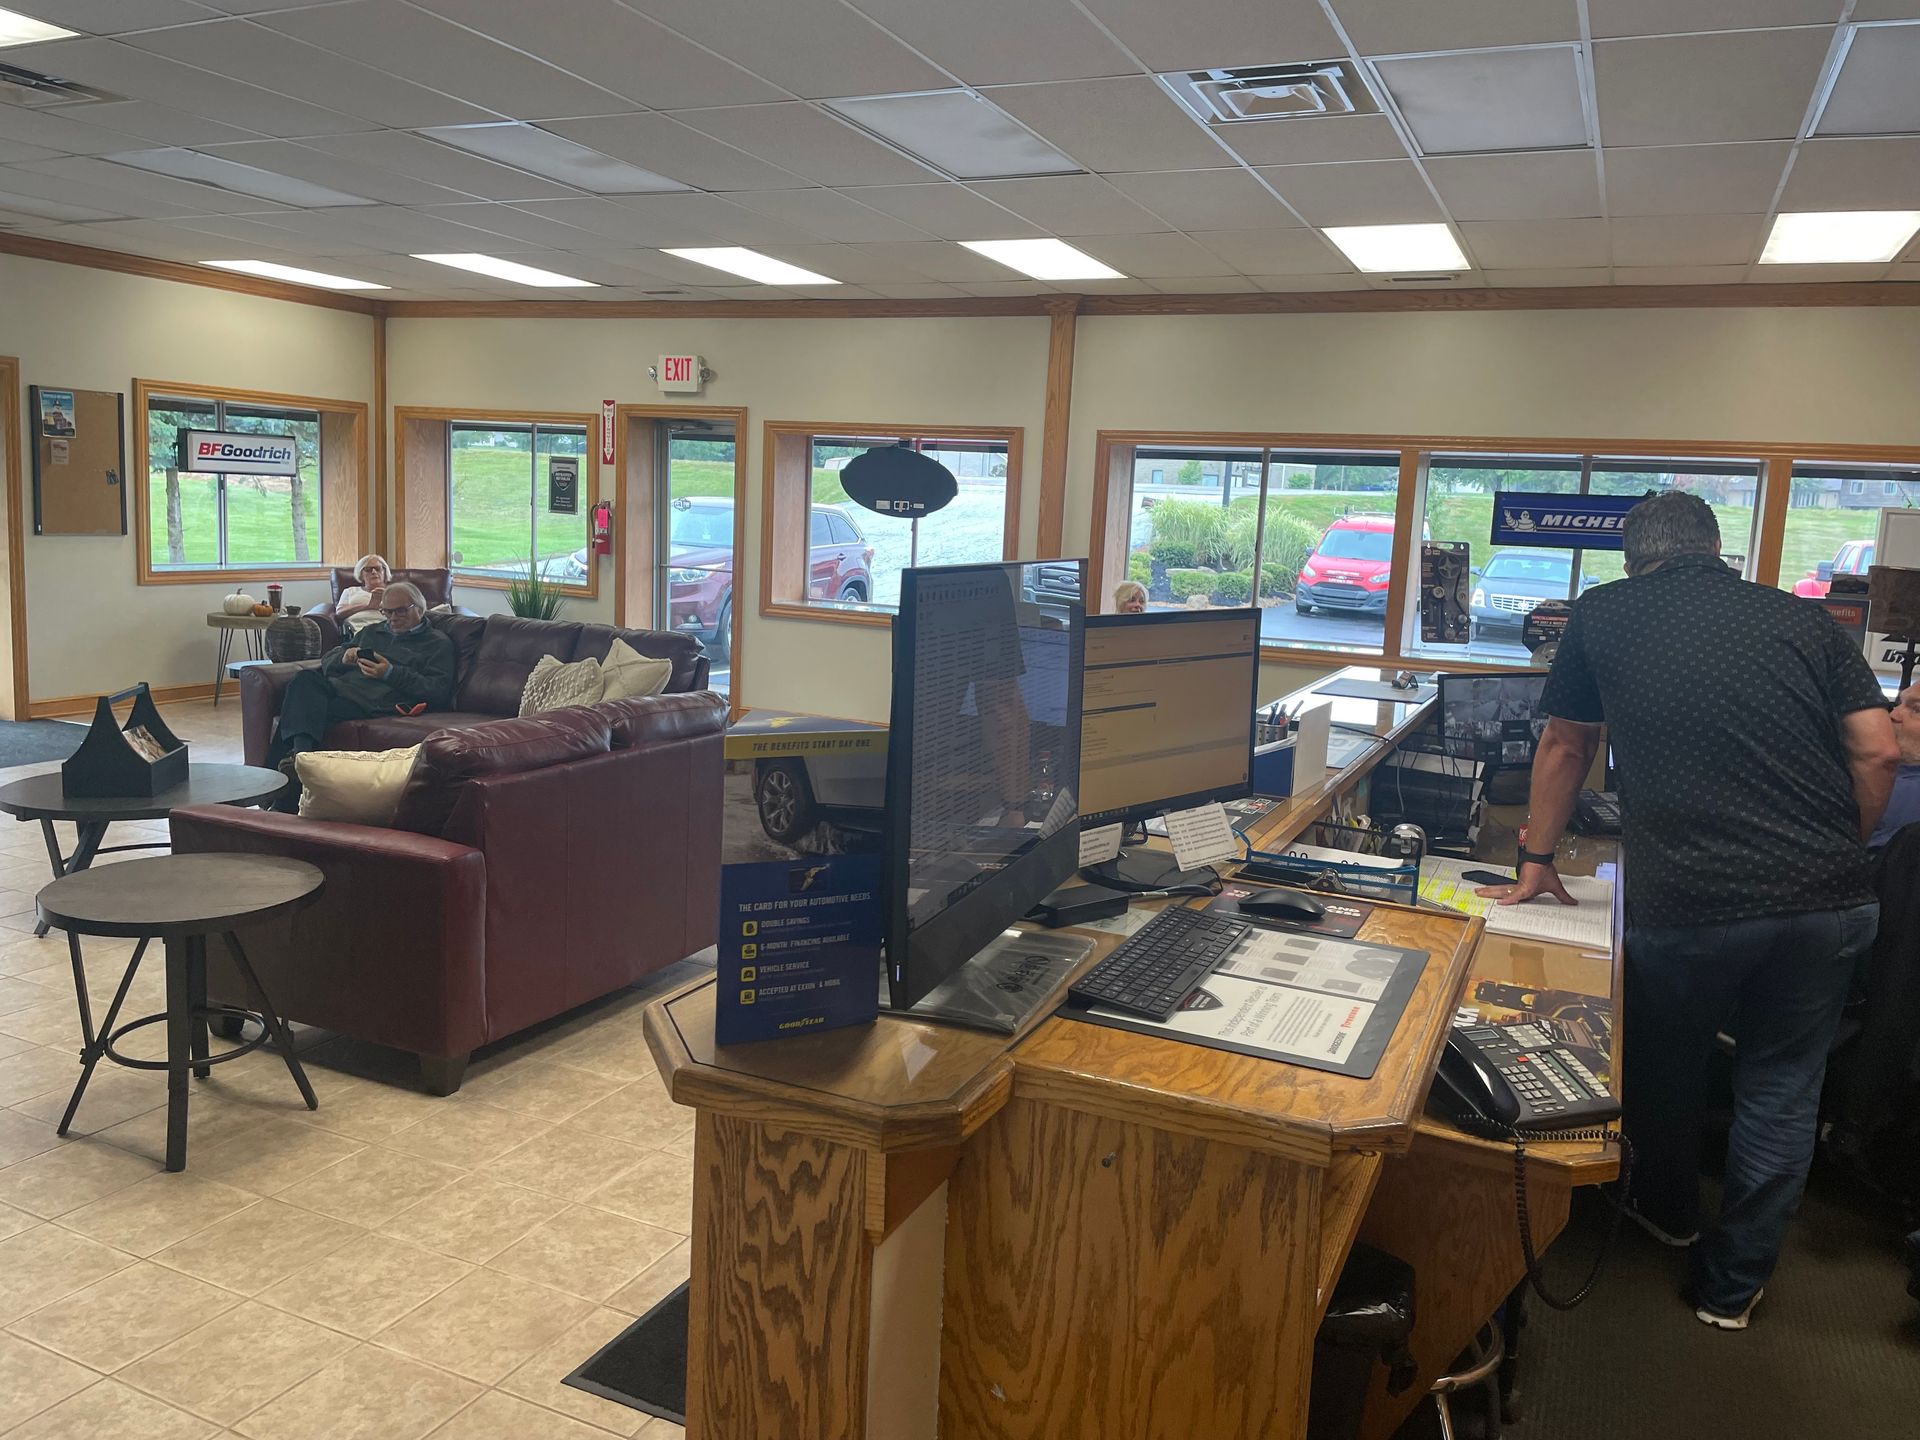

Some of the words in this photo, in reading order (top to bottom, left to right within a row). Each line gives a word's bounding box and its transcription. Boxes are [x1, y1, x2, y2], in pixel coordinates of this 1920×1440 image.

[665, 357, 692, 381] EXIT
[198, 442, 291, 460] BFGoodrich
[753, 743, 767, 751] THE
[771, 741, 809, 750] BENEFITS
[812, 740, 836, 749] START
[839, 739, 853, 748] DAY
[739, 903, 752, 912] THE
[754, 902, 773, 911] CARD
[774, 901, 788, 910] FOR
[789, 899, 808, 908] YOUR
[809, 894, 849, 906] AUTOMOTIVE
[761, 918, 785, 928] DOUBLE
[786, 916, 810, 926] SAVINGS
[790, 937, 821, 947] FINANCING
[822, 933, 851, 943] AVAILABLE
[760, 963, 784, 973] VEHICLE
[785, 961, 810, 970] SERVICE
[759, 985, 789, 996] ACCEPTED
[789, 984, 797, 992] AT
[779, 1017, 824, 1029] GOODYEAR
